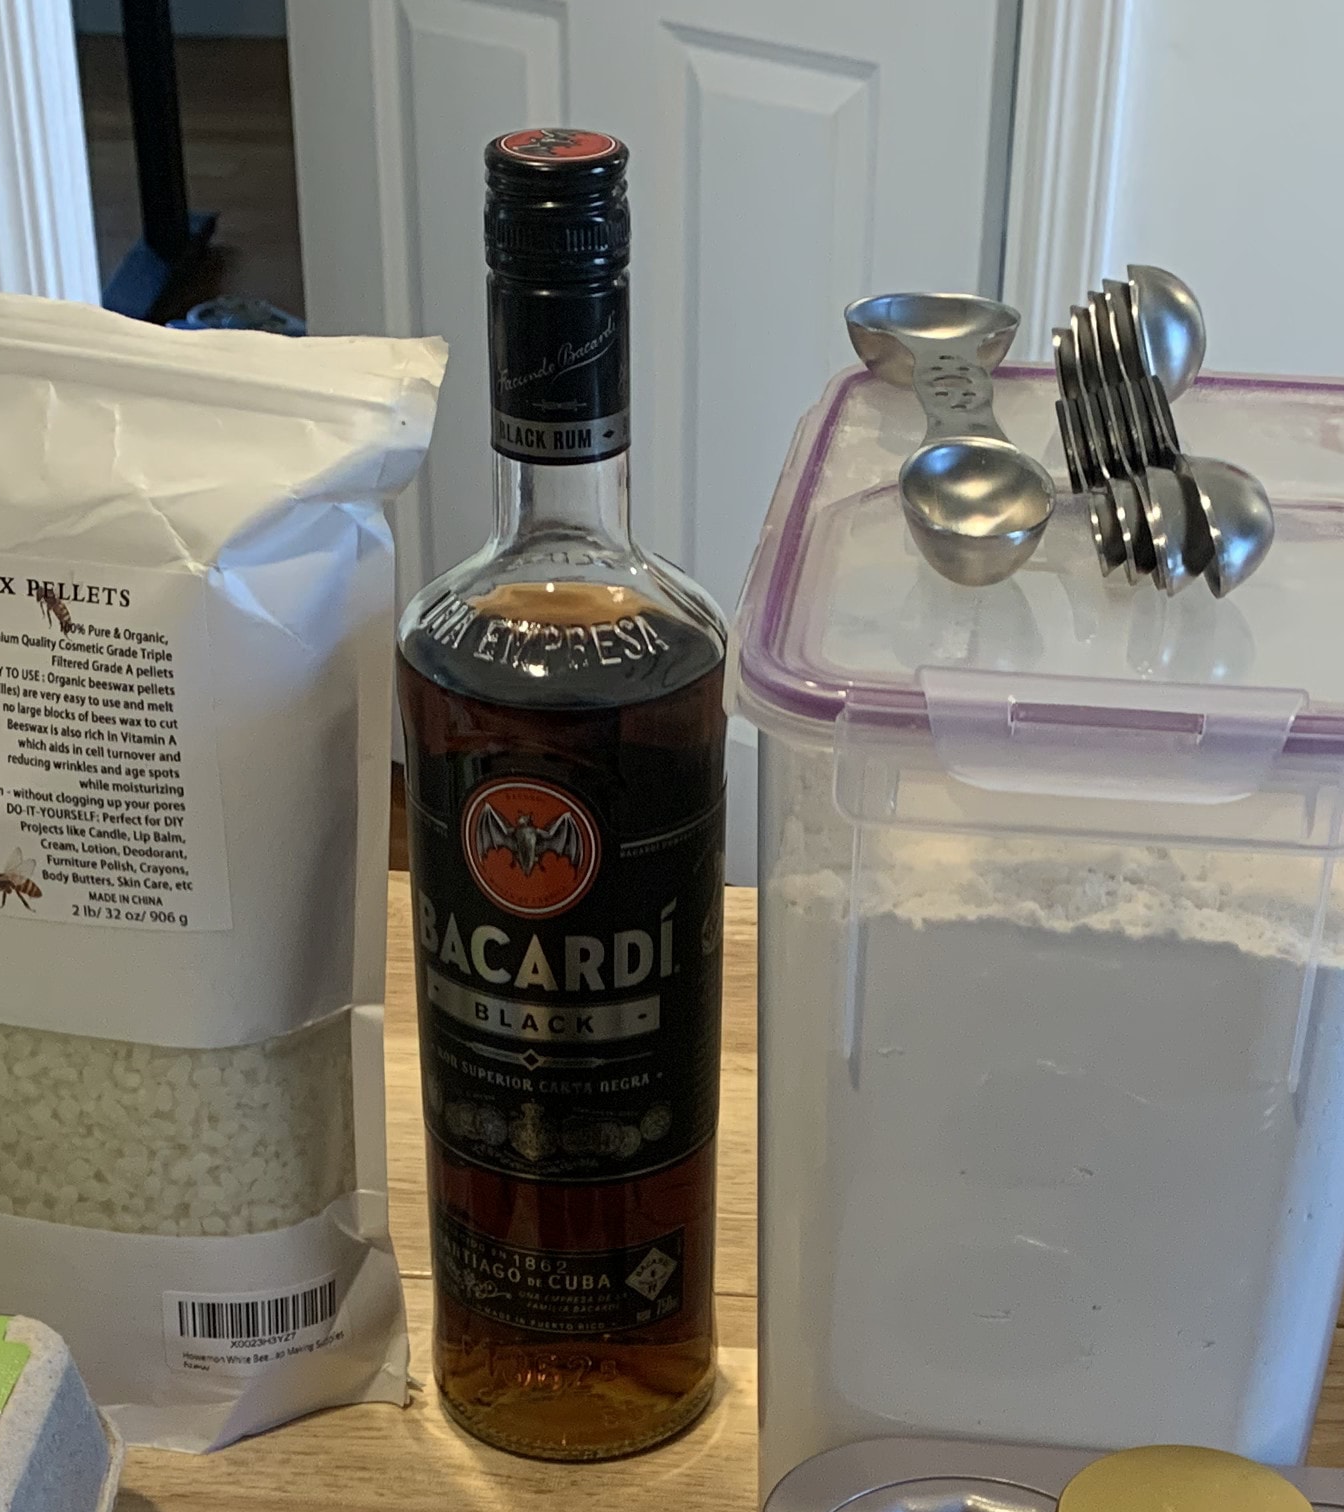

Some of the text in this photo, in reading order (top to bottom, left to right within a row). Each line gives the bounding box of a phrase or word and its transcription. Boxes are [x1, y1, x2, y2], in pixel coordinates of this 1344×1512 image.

[499, 418, 592, 450] BLACK RUM
[25, 578, 130, 607] PELLETS
[87, 623, 111, 638] Pure
[112, 626, 121, 639] &
[122, 627, 168, 646] Organic,
[20, 633, 57, 651] Quality
[57, 635, 104, 655] Cosmetic
[105, 643, 138, 659] Grade
[139, 647, 172, 663] Triple
[50, 654, 174, 678] Filtered Grade A pellets
[4, 665, 19, 679] TO
[21, 668, 40, 682] USE
[46, 671, 86, 688] Organic
[87, 676, 134, 693] beeswax
[136, 682, 175, 696] pellets
[5, 802, 184, 827] DO-IT-YOURSELF: Perfect for DIY
[41, 868, 193, 891] Body Butters, Skin Care, etc
[87, 890, 163, 906] MADE IN CHINA
[71, 903, 188, 927] 2 lb/ 32 oz/ 906 g
[419, 895, 677, 992] BACARDÍ
[474, 1001, 595, 1035] BLACK
[461, 1057, 534, 1093] SUPERIOR
[512, 1254, 569, 1274] 1862
[548, 1273, 612, 1291] CUBA
